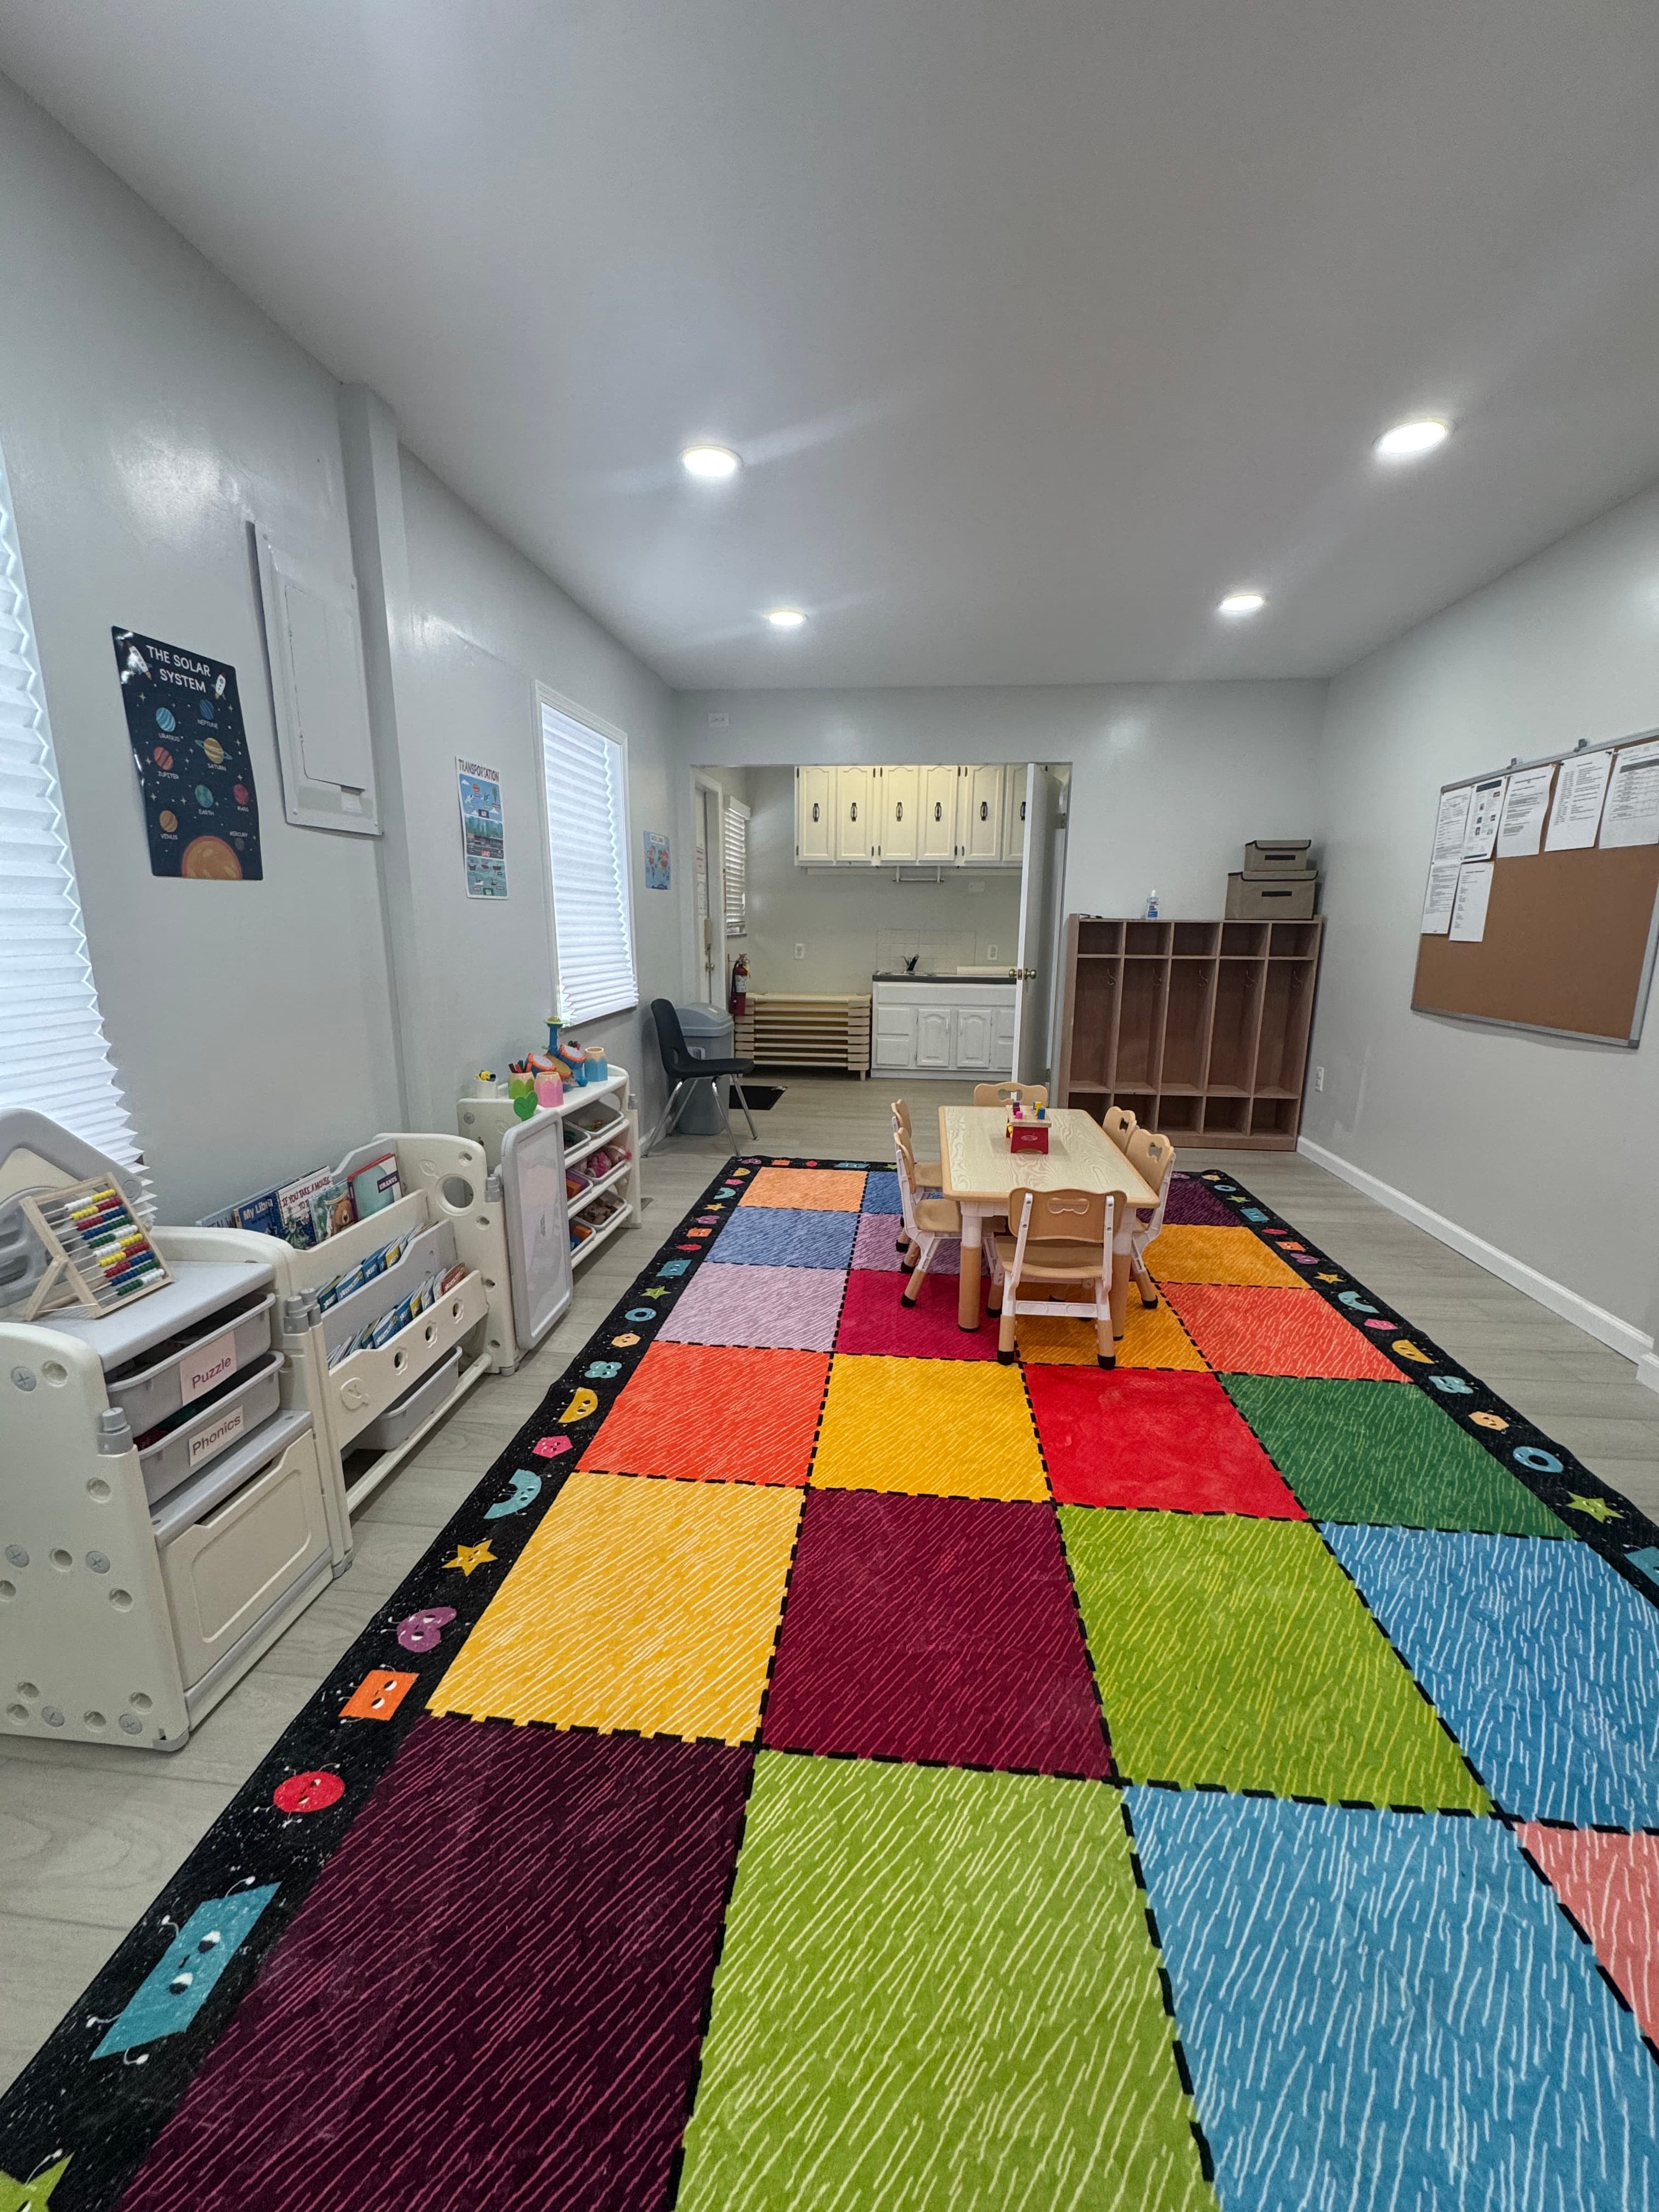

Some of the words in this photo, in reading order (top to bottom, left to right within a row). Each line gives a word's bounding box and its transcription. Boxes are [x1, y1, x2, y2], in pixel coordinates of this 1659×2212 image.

[146, 645, 171, 664] THE
[174, 654, 211, 677] SOLAR
[160, 668, 206, 693] SYSTEM
[198, 719, 218, 729] NEPTUNE
[158, 732, 180, 742] URANUS
[158, 771, 179, 779] JUPITER
[459, 759, 499, 783] TRANSPORTATION
[282, 1197, 287, 1207] IF
[289, 1192, 298, 1203] YOU
[298, 1186, 312, 1198] TAKE
[315, 1176, 330, 1190] MOUSE
[379, 1176, 397, 1190] URANUS
[243, 1209, 254, 1220] My
[298, 1201, 306, 1210] TO
[192, 1357, 231, 1389] Puzzle
[193, 1416, 241, 1455] Phonics
